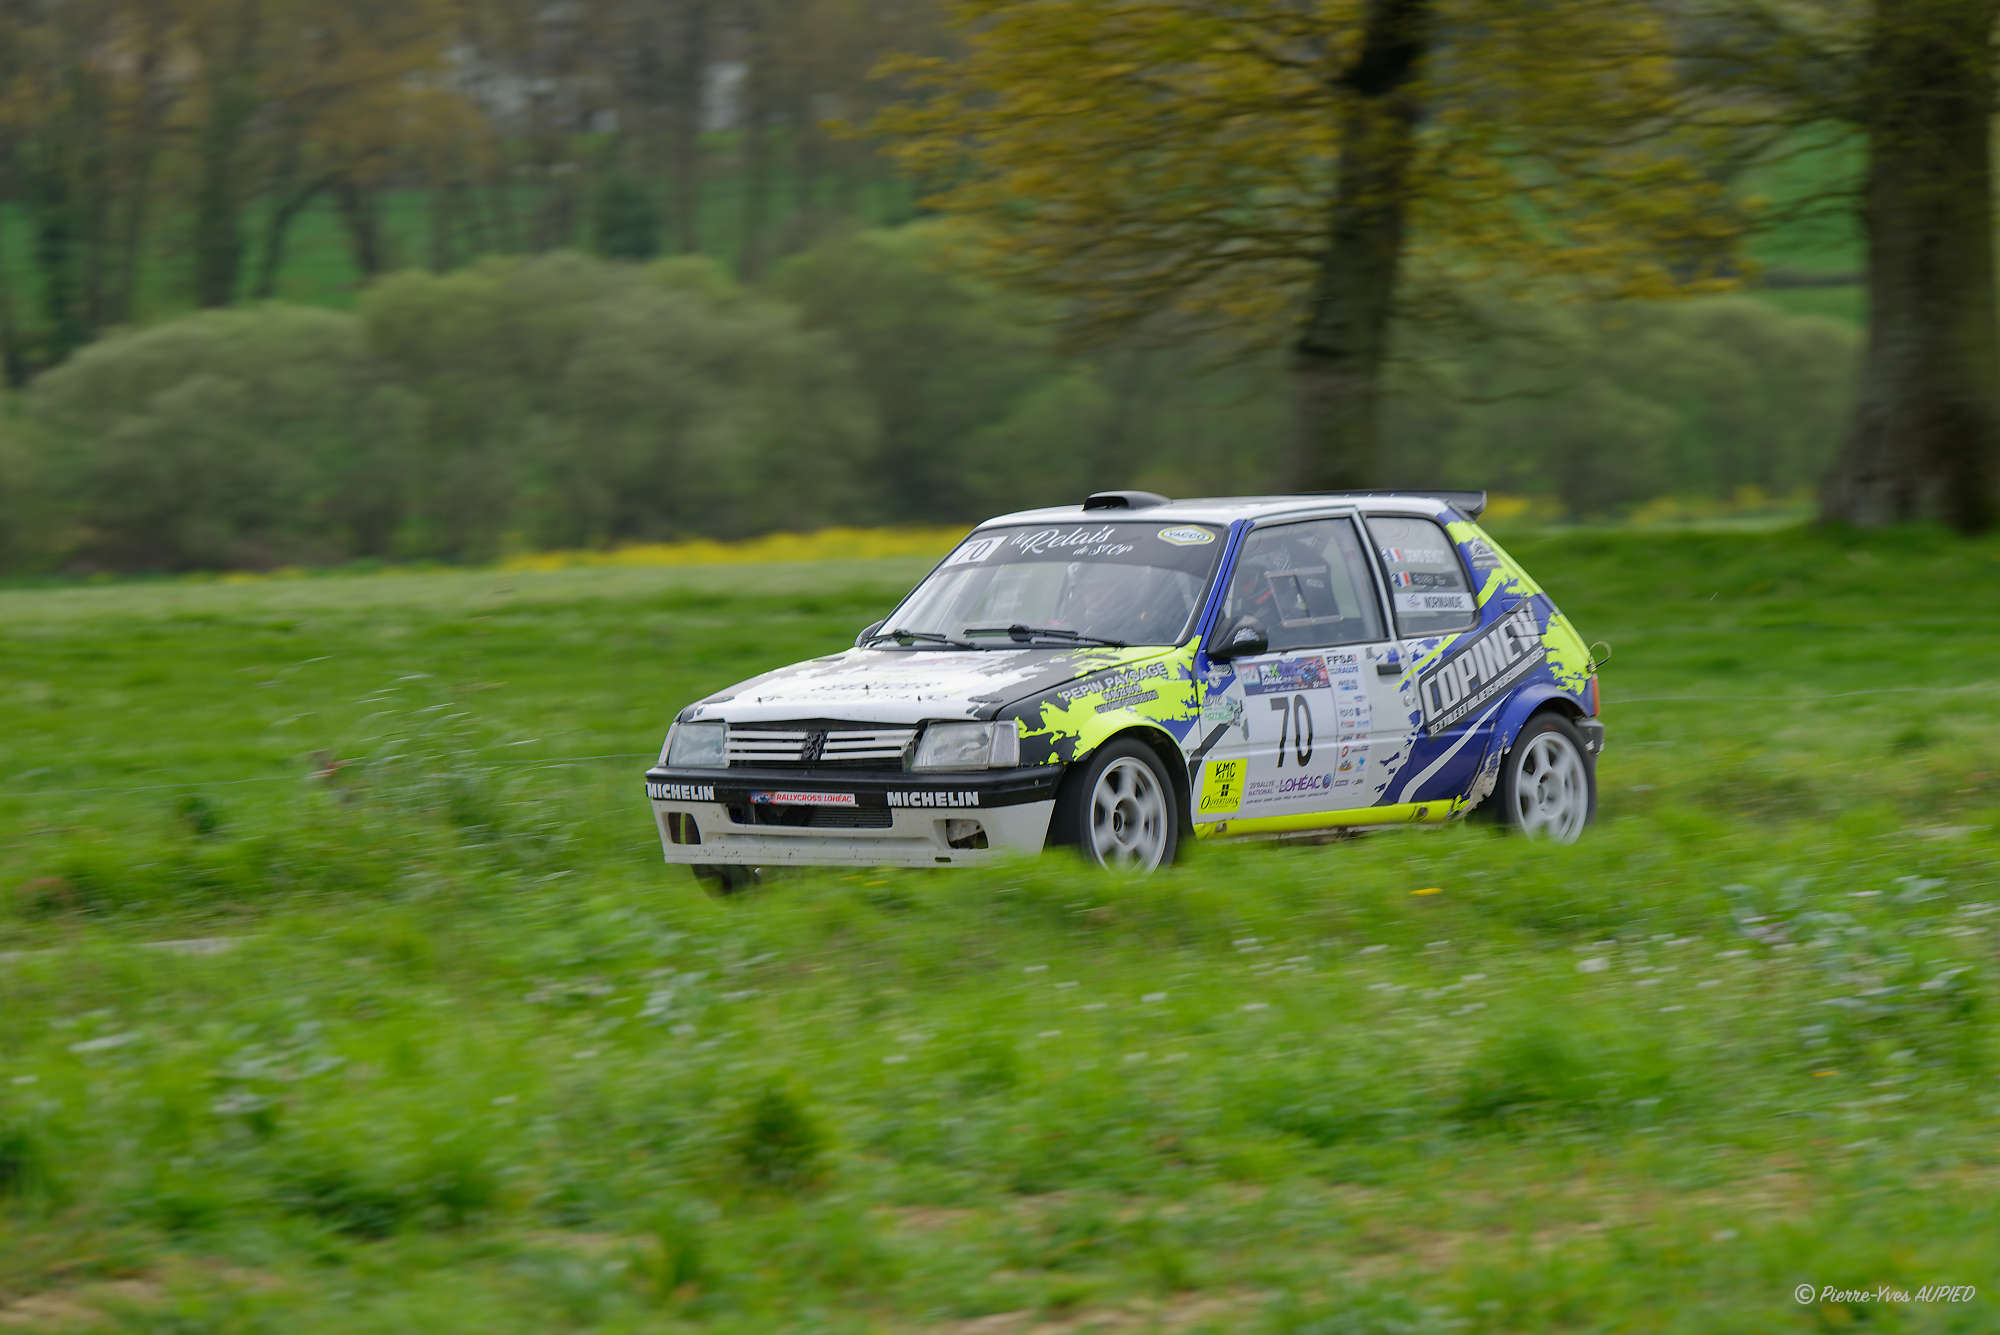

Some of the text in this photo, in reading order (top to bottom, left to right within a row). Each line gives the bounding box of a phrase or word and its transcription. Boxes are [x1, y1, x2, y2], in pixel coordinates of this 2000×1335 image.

[1019, 525, 1115, 555] Relais
[1327, 654, 1353, 664] FFSA
[1421, 601, 1541, 722] COPINEW
[1061, 680, 1104, 702] PEPIN
[1104, 661, 1168, 687] PAYSAGE
[1270, 694, 1313, 768] 70
[646, 783, 714, 801] MICHELIN
[1278, 775, 1321, 793] LOHÉAC
[776, 793, 852, 803] RALLYCROSS LOHÉAC
[887, 791, 980, 807] MICHELIN
